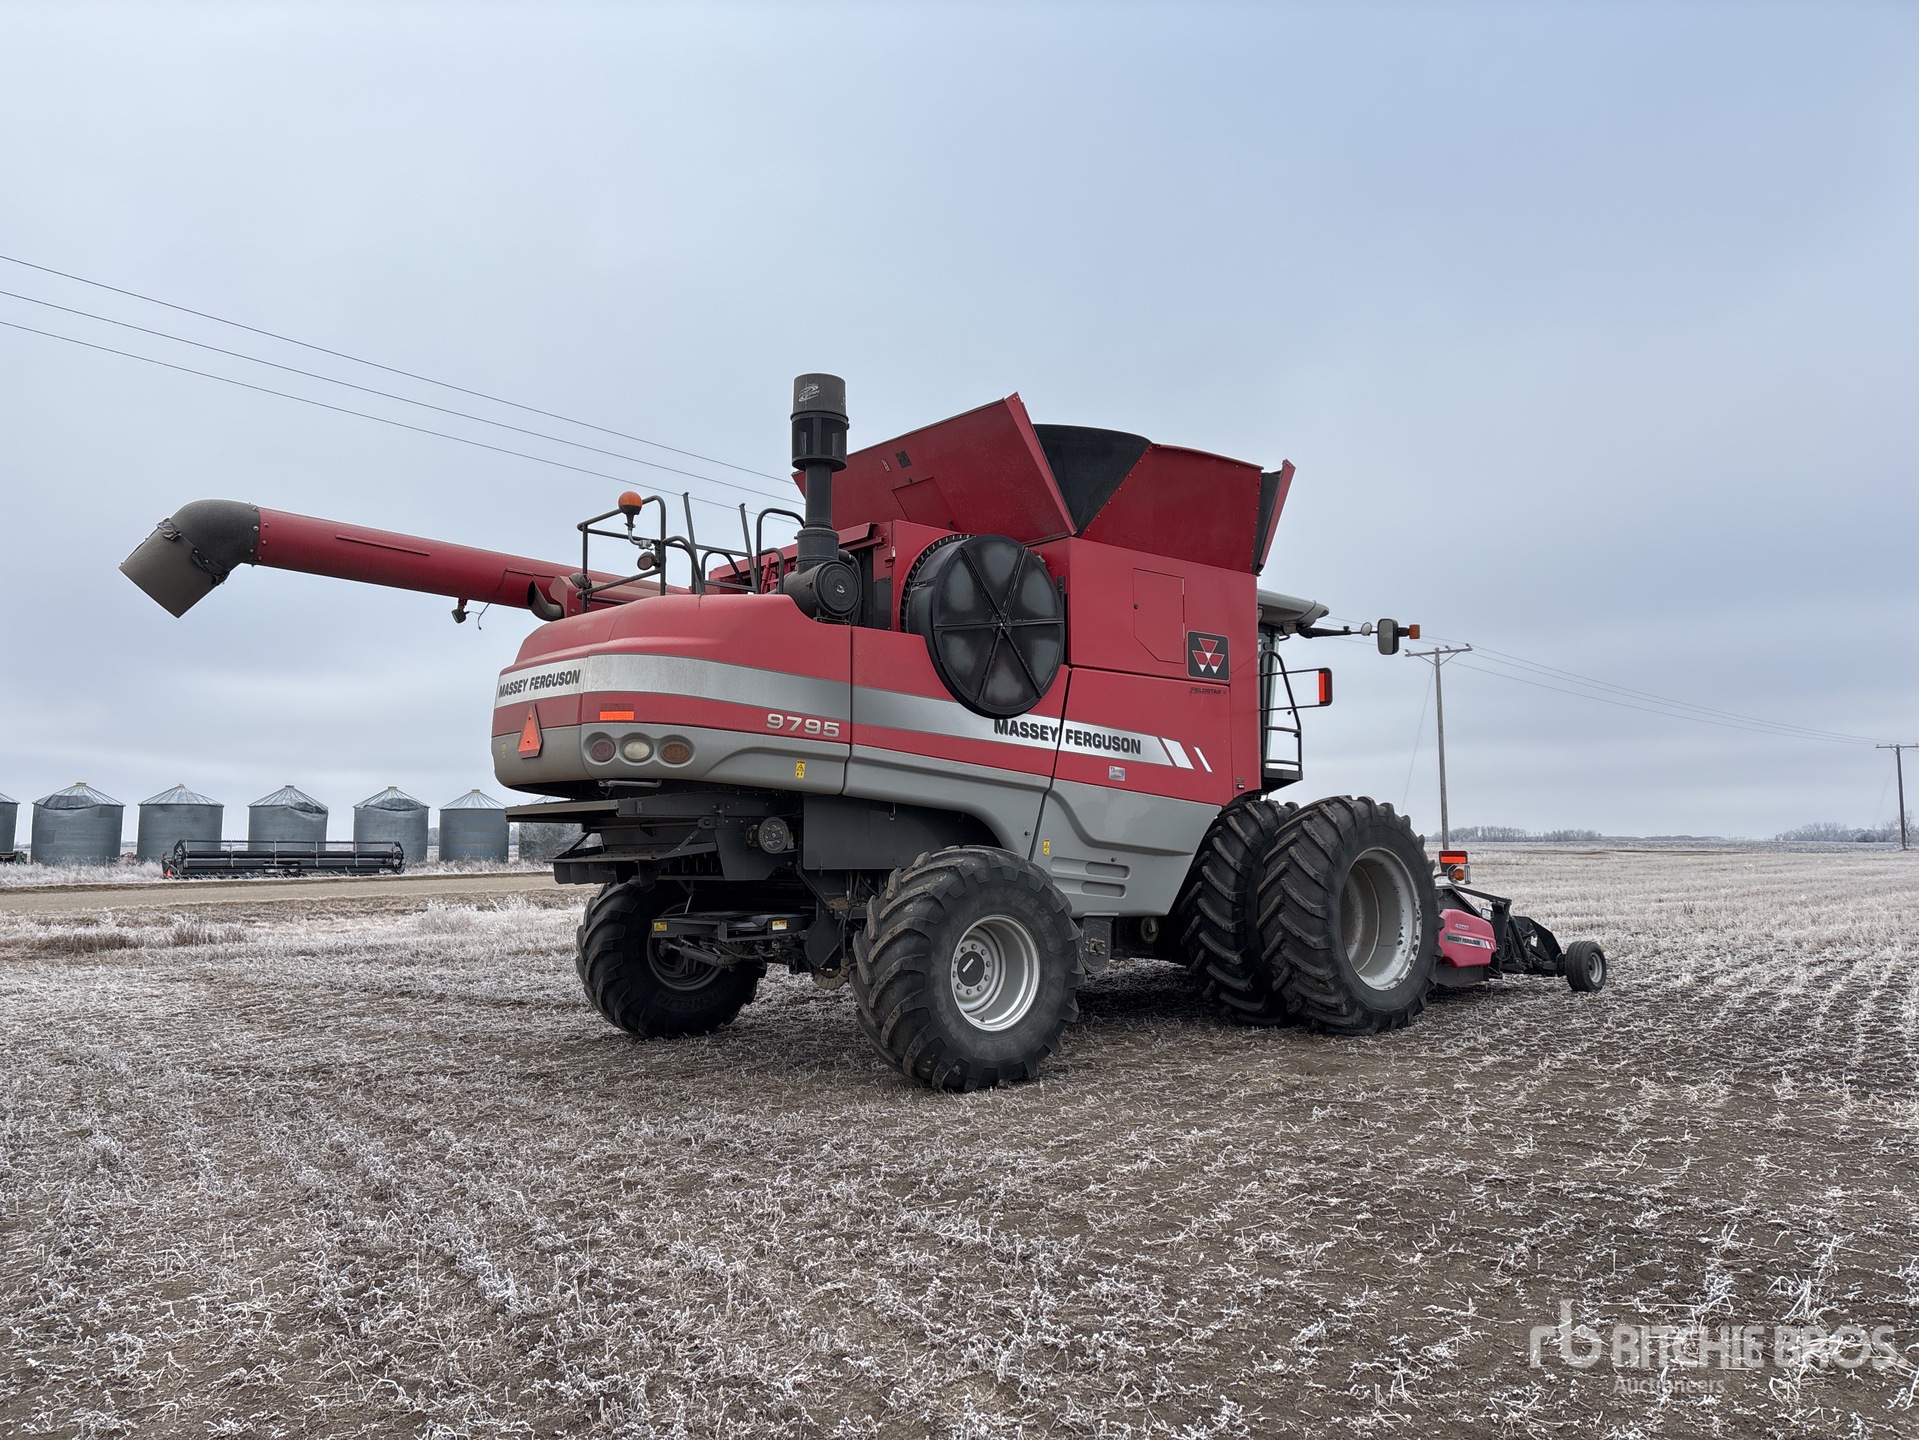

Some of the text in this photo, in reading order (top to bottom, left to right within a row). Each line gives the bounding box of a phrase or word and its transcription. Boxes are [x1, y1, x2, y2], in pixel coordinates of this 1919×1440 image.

[499, 669, 581, 698] MASSEY FERGUSON
[766, 713, 840, 737] 9795
[993, 718, 1141, 755] MASSEY FERGUSON
